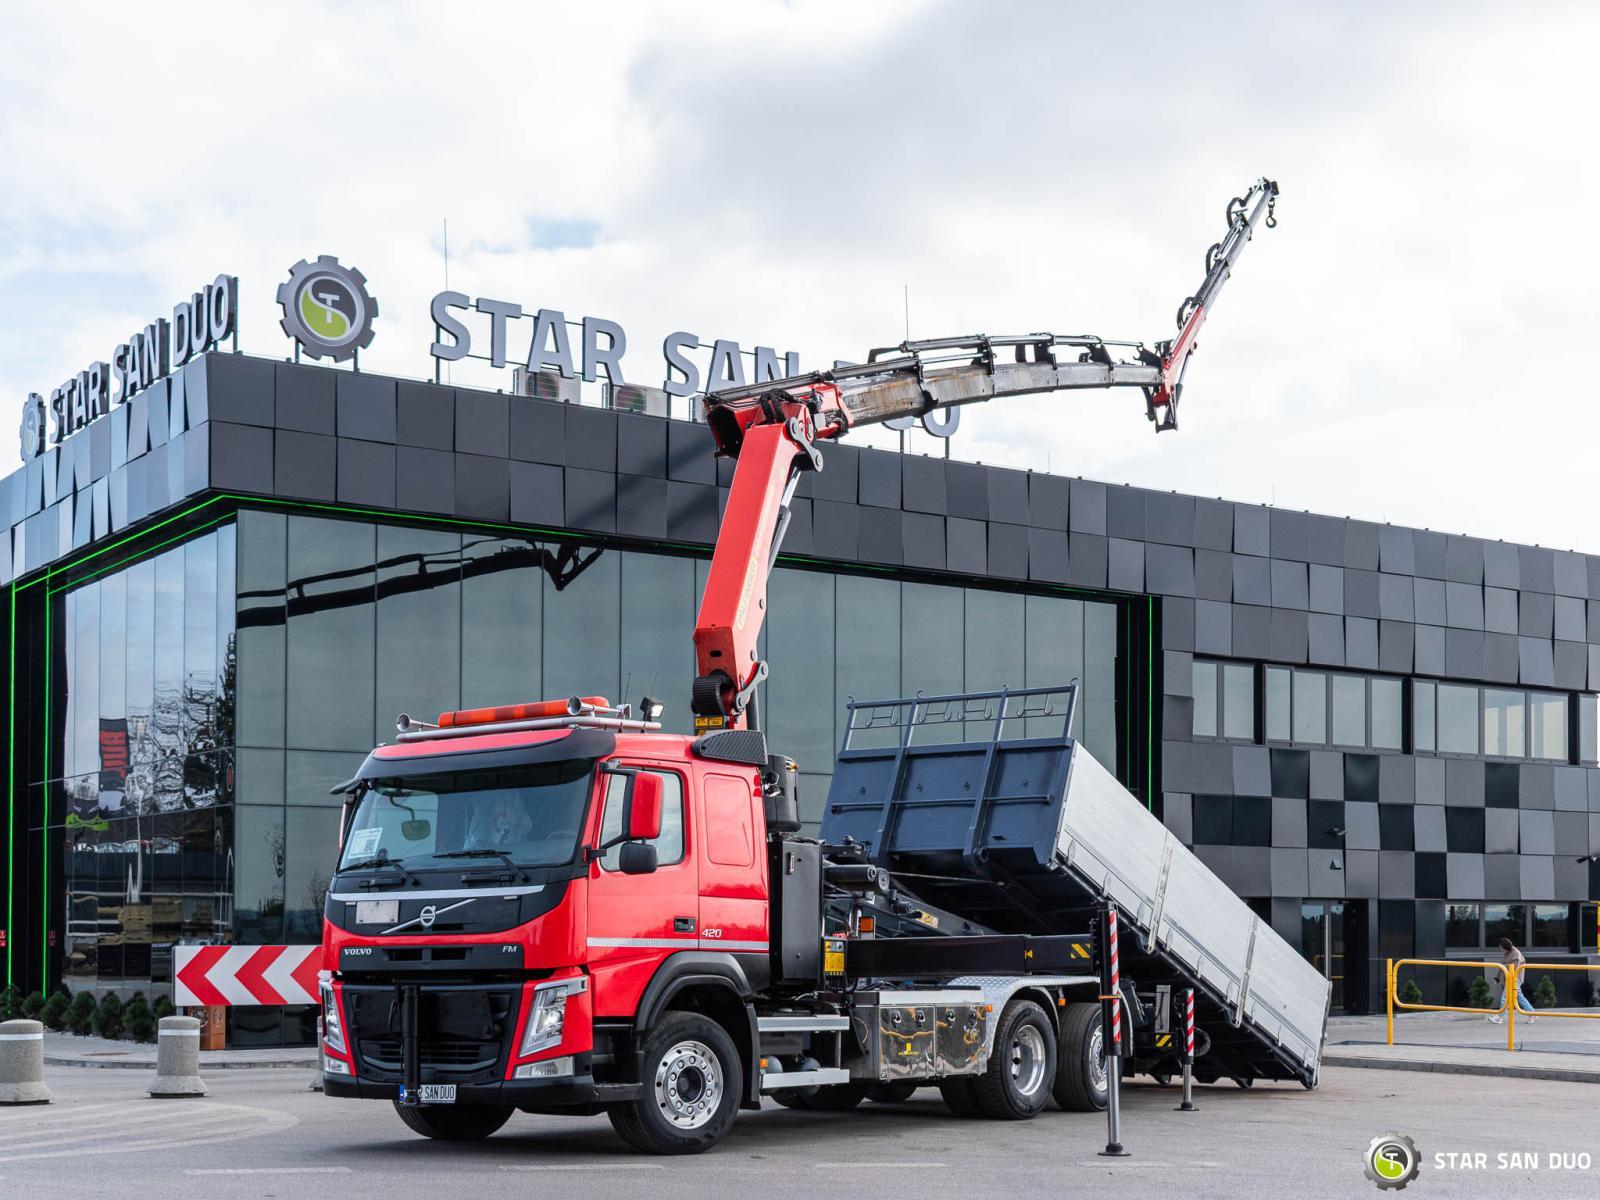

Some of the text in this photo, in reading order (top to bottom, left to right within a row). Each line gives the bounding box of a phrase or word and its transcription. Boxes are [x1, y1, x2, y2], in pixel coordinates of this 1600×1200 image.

[430, 291, 627, 387] STAR
[50, 274, 235, 443] STAR SAN DUO
[702, 928, 722, 938] 420
[344, 947, 372, 956] VOLVO
[502, 945, 518, 953] FM
[424, 1086, 438, 1100] SAN
[440, 1086, 455, 1100] DUO
